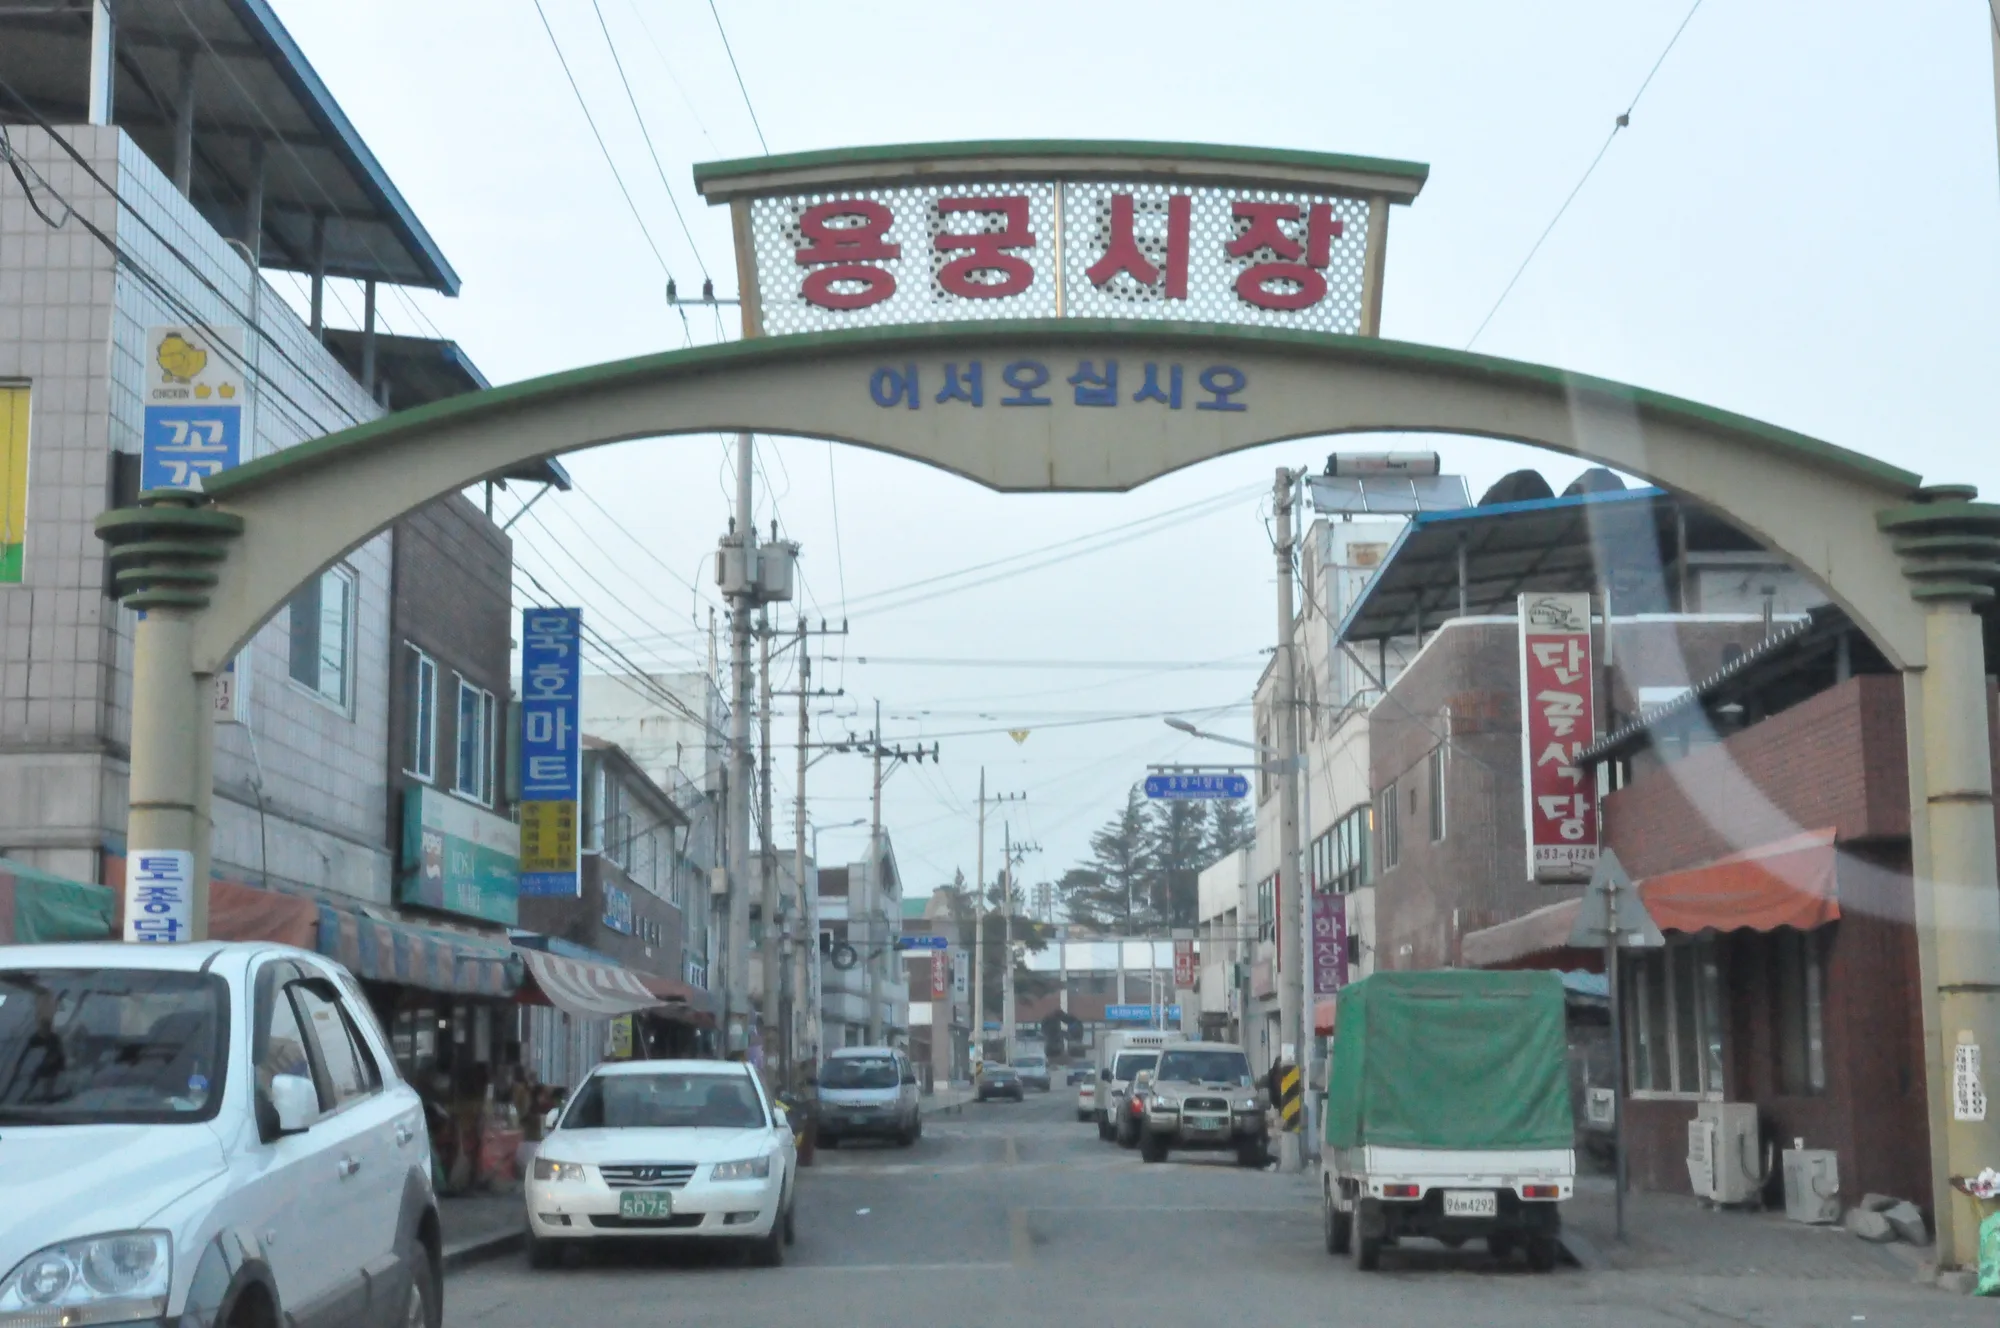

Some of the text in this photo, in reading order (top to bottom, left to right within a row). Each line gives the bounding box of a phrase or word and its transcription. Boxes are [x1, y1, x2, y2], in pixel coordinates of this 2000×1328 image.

[794, 193, 1344, 311] 용궁시장
[152, 388, 190, 400] CHICKEN
[869, 360, 1248, 412] 어서오십시오
[524, 616, 573, 791] 묵호마트
[1531, 638, 1591, 841] 단골식당
[1315, 916, 1342, 993] 화장품
[623, 1199, 669, 1218] 5075
